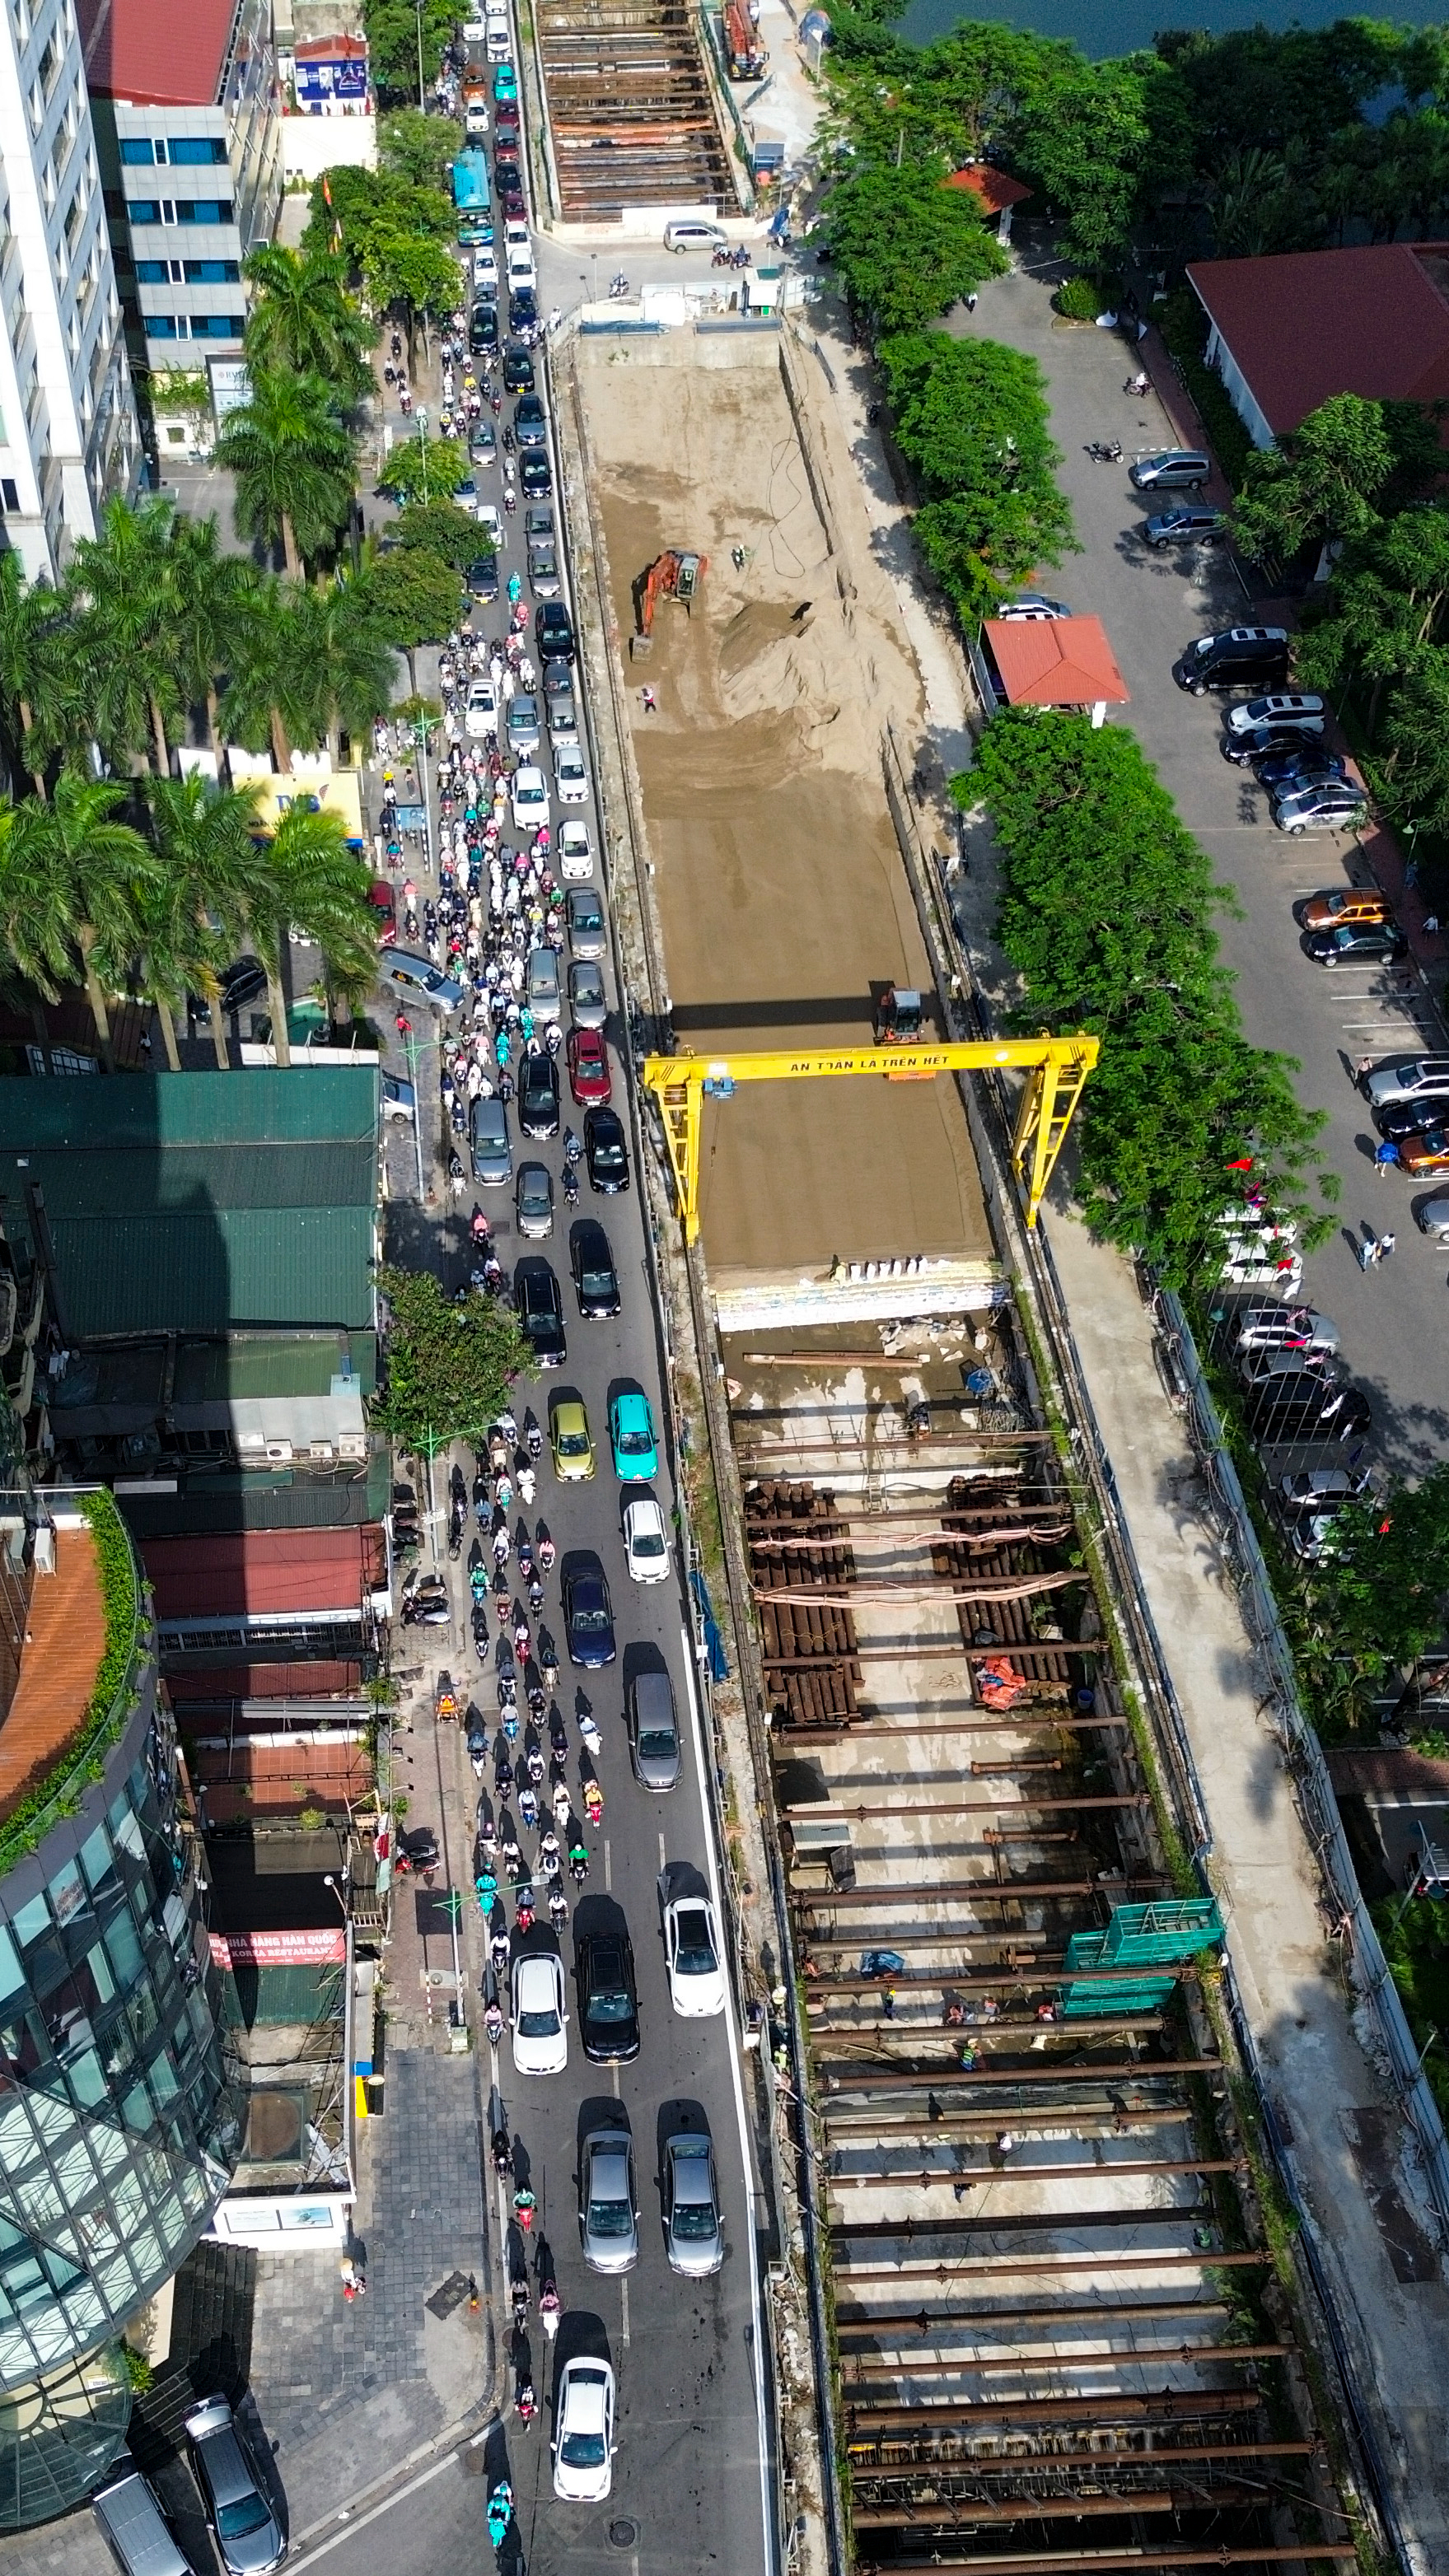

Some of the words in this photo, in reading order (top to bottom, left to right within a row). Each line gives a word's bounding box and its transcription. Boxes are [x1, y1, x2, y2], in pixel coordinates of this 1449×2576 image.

[791, 1063, 810, 1071] AN
[860, 1057, 876, 1068] LÀ
[881, 1056, 917, 1067] TRÊN
[923, 1053, 949, 1065] HẾT
[227, 1936, 248, 1948] NHÀ
[250, 1935, 280, 1947] HÀNG
[282, 1934, 306, 1946] HÀN
[307, 1932, 337, 1945] QUỐC
[231, 1949, 266, 1958] KOREA
[267, 1947, 334, 1957] RESTAURANT
